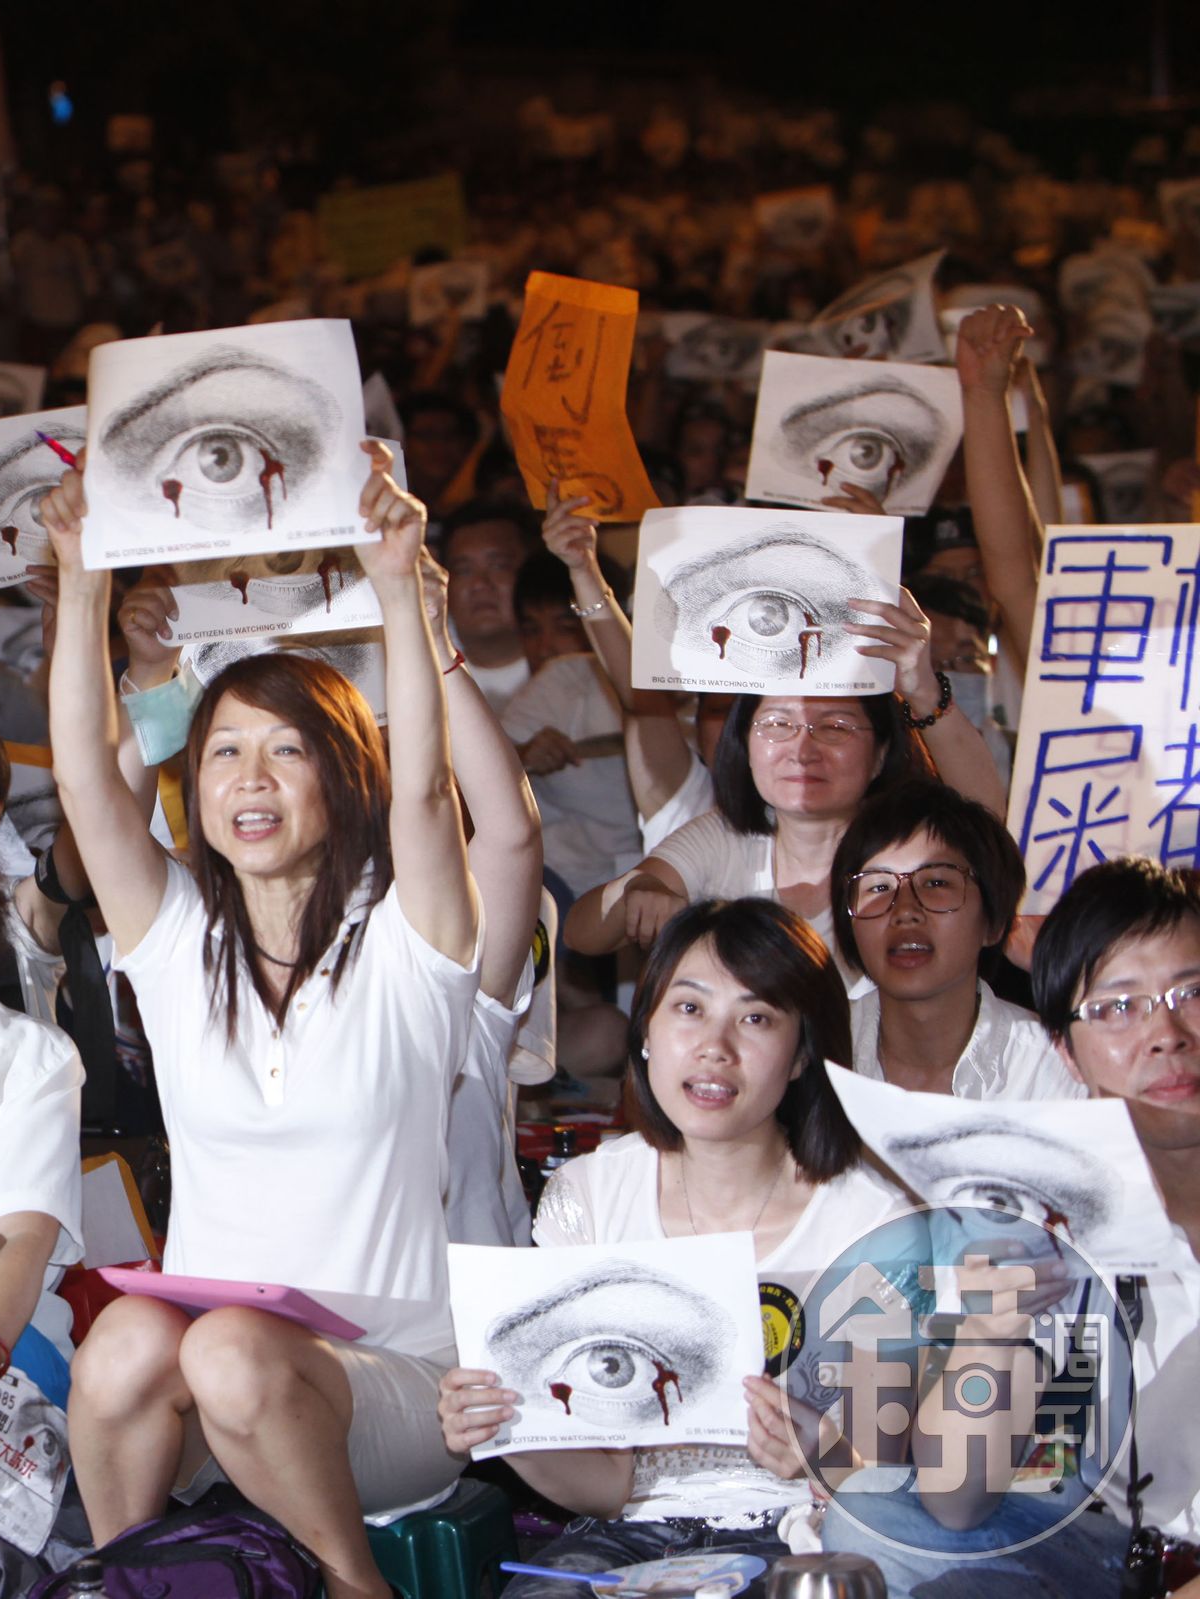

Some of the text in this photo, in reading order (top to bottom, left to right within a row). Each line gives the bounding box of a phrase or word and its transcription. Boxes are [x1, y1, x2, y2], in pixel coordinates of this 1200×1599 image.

[105, 539, 231, 559] BIG CITIZEN IS WATCHING YOU
[177, 621, 293, 641] BIG CITIZEN IS WATCHING YOU
[652, 676, 666, 684] BIG
[667, 676, 697, 686] CITIZEN
[708, 679, 749, 688] WATCHING
[748, 681, 765, 689] YOU
[494, 1433, 627, 1447] BIG CITIZEN IS WATCHING YOU
